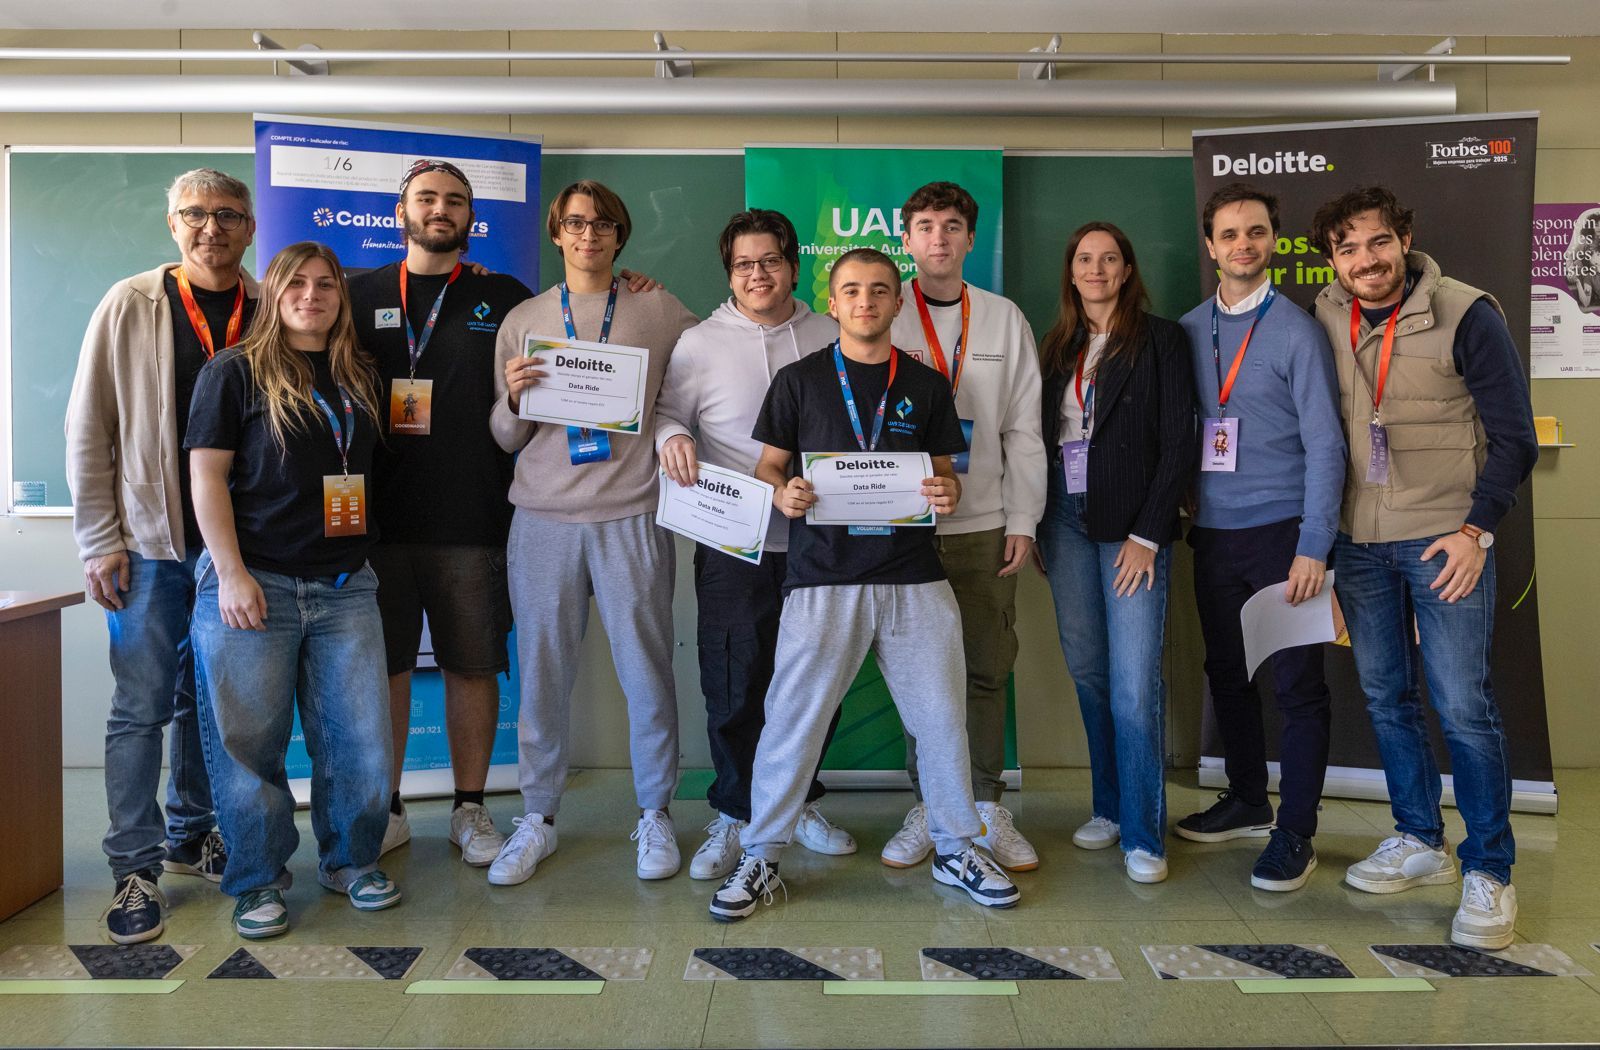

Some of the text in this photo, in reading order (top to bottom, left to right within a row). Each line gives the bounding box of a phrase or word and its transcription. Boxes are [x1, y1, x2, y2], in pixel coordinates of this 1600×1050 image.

[1431, 140, 1511, 158] Forbes 100
[324, 156, 352, 171] 1/6
[1212, 151, 1334, 176] Deloitte.
[1533, 233, 1569, 246] vant
[1531, 246, 1593, 262] olències
[1531, 262, 1597, 276] asclistes
[555, 355, 616, 373] Deloitte.
[568, 382, 600, 392] Data Ride
[835, 460, 900, 471] Deloitte.
[696, 479, 743, 500] eloitte.
[698, 500, 725, 515] Data Ride
[409, 726, 442, 735] 300 321
